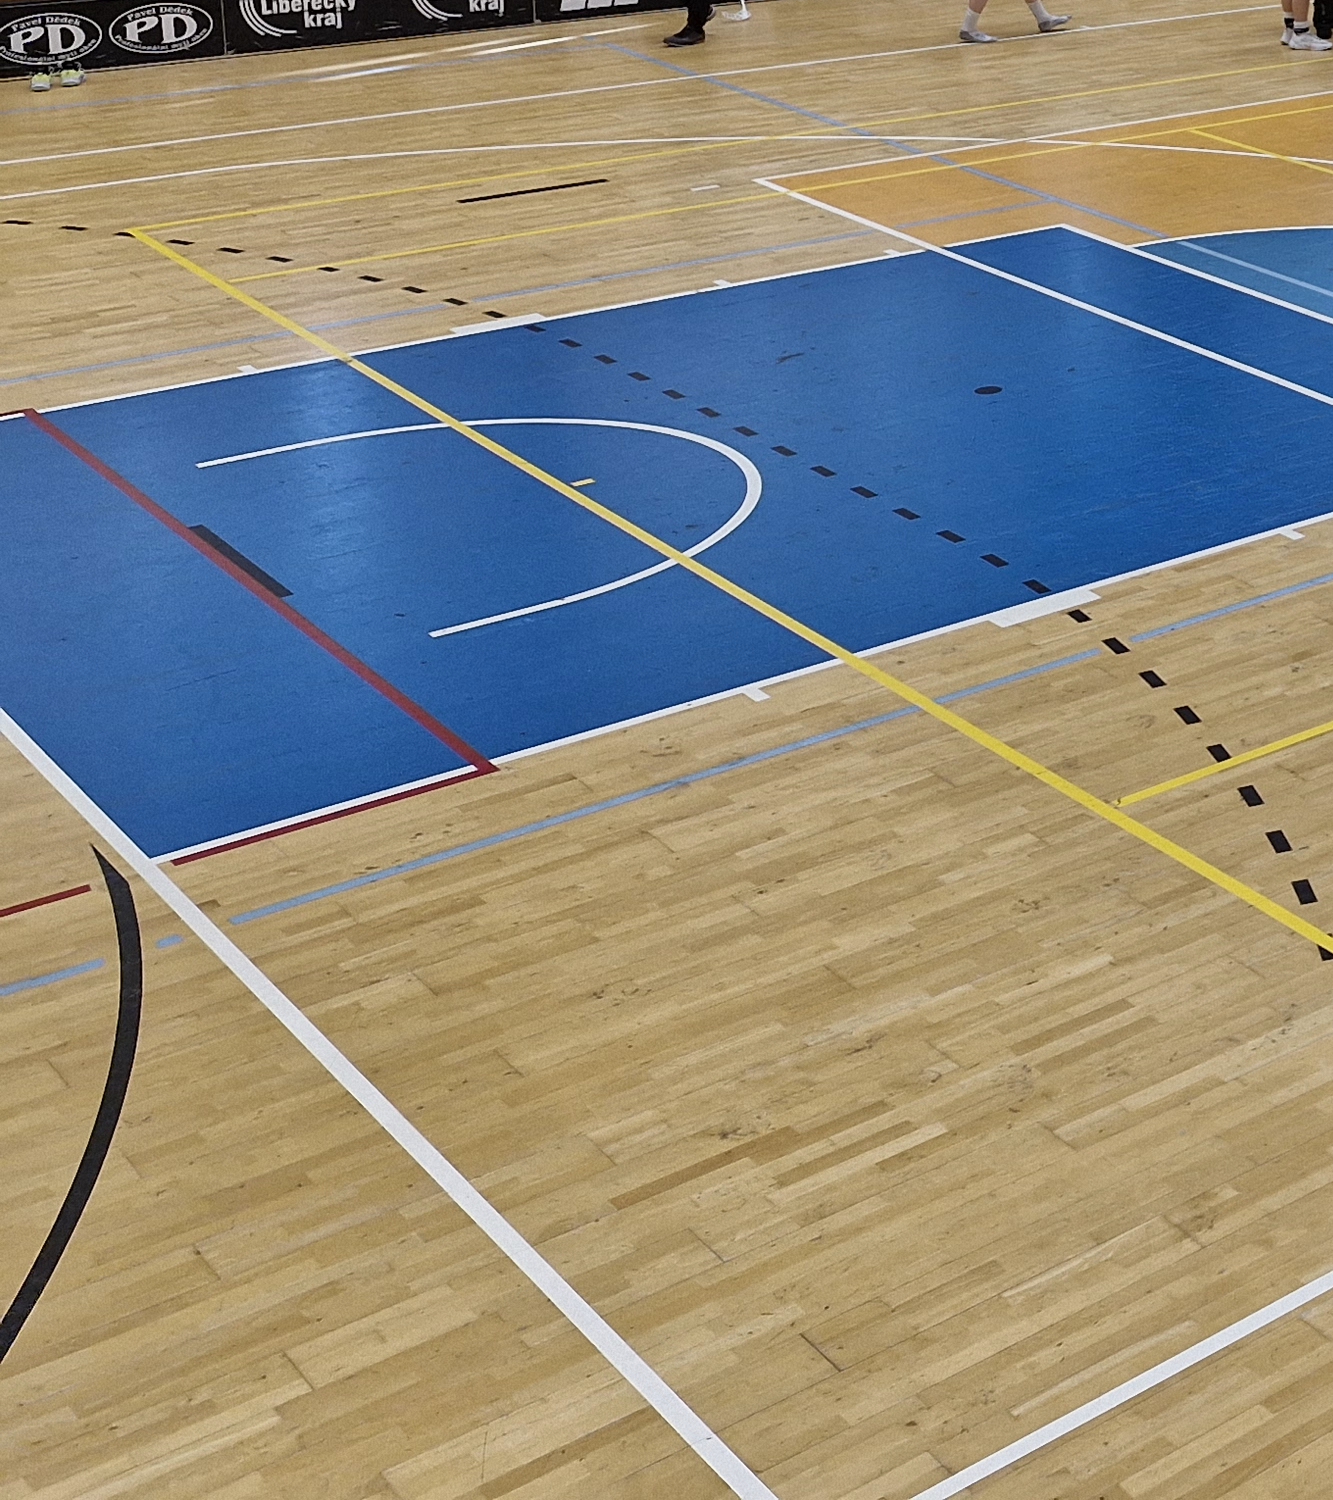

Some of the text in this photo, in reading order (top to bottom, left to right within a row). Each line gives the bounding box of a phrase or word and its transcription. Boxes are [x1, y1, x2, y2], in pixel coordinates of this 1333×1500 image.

[11, 16, 81, 32] Pavel Dědek
[127, 6, 193, 21] Pavel Dědek
[303, 8, 343, 29] kraj
[123, 13, 198, 44] PD
[7, 24, 86, 55] PD
